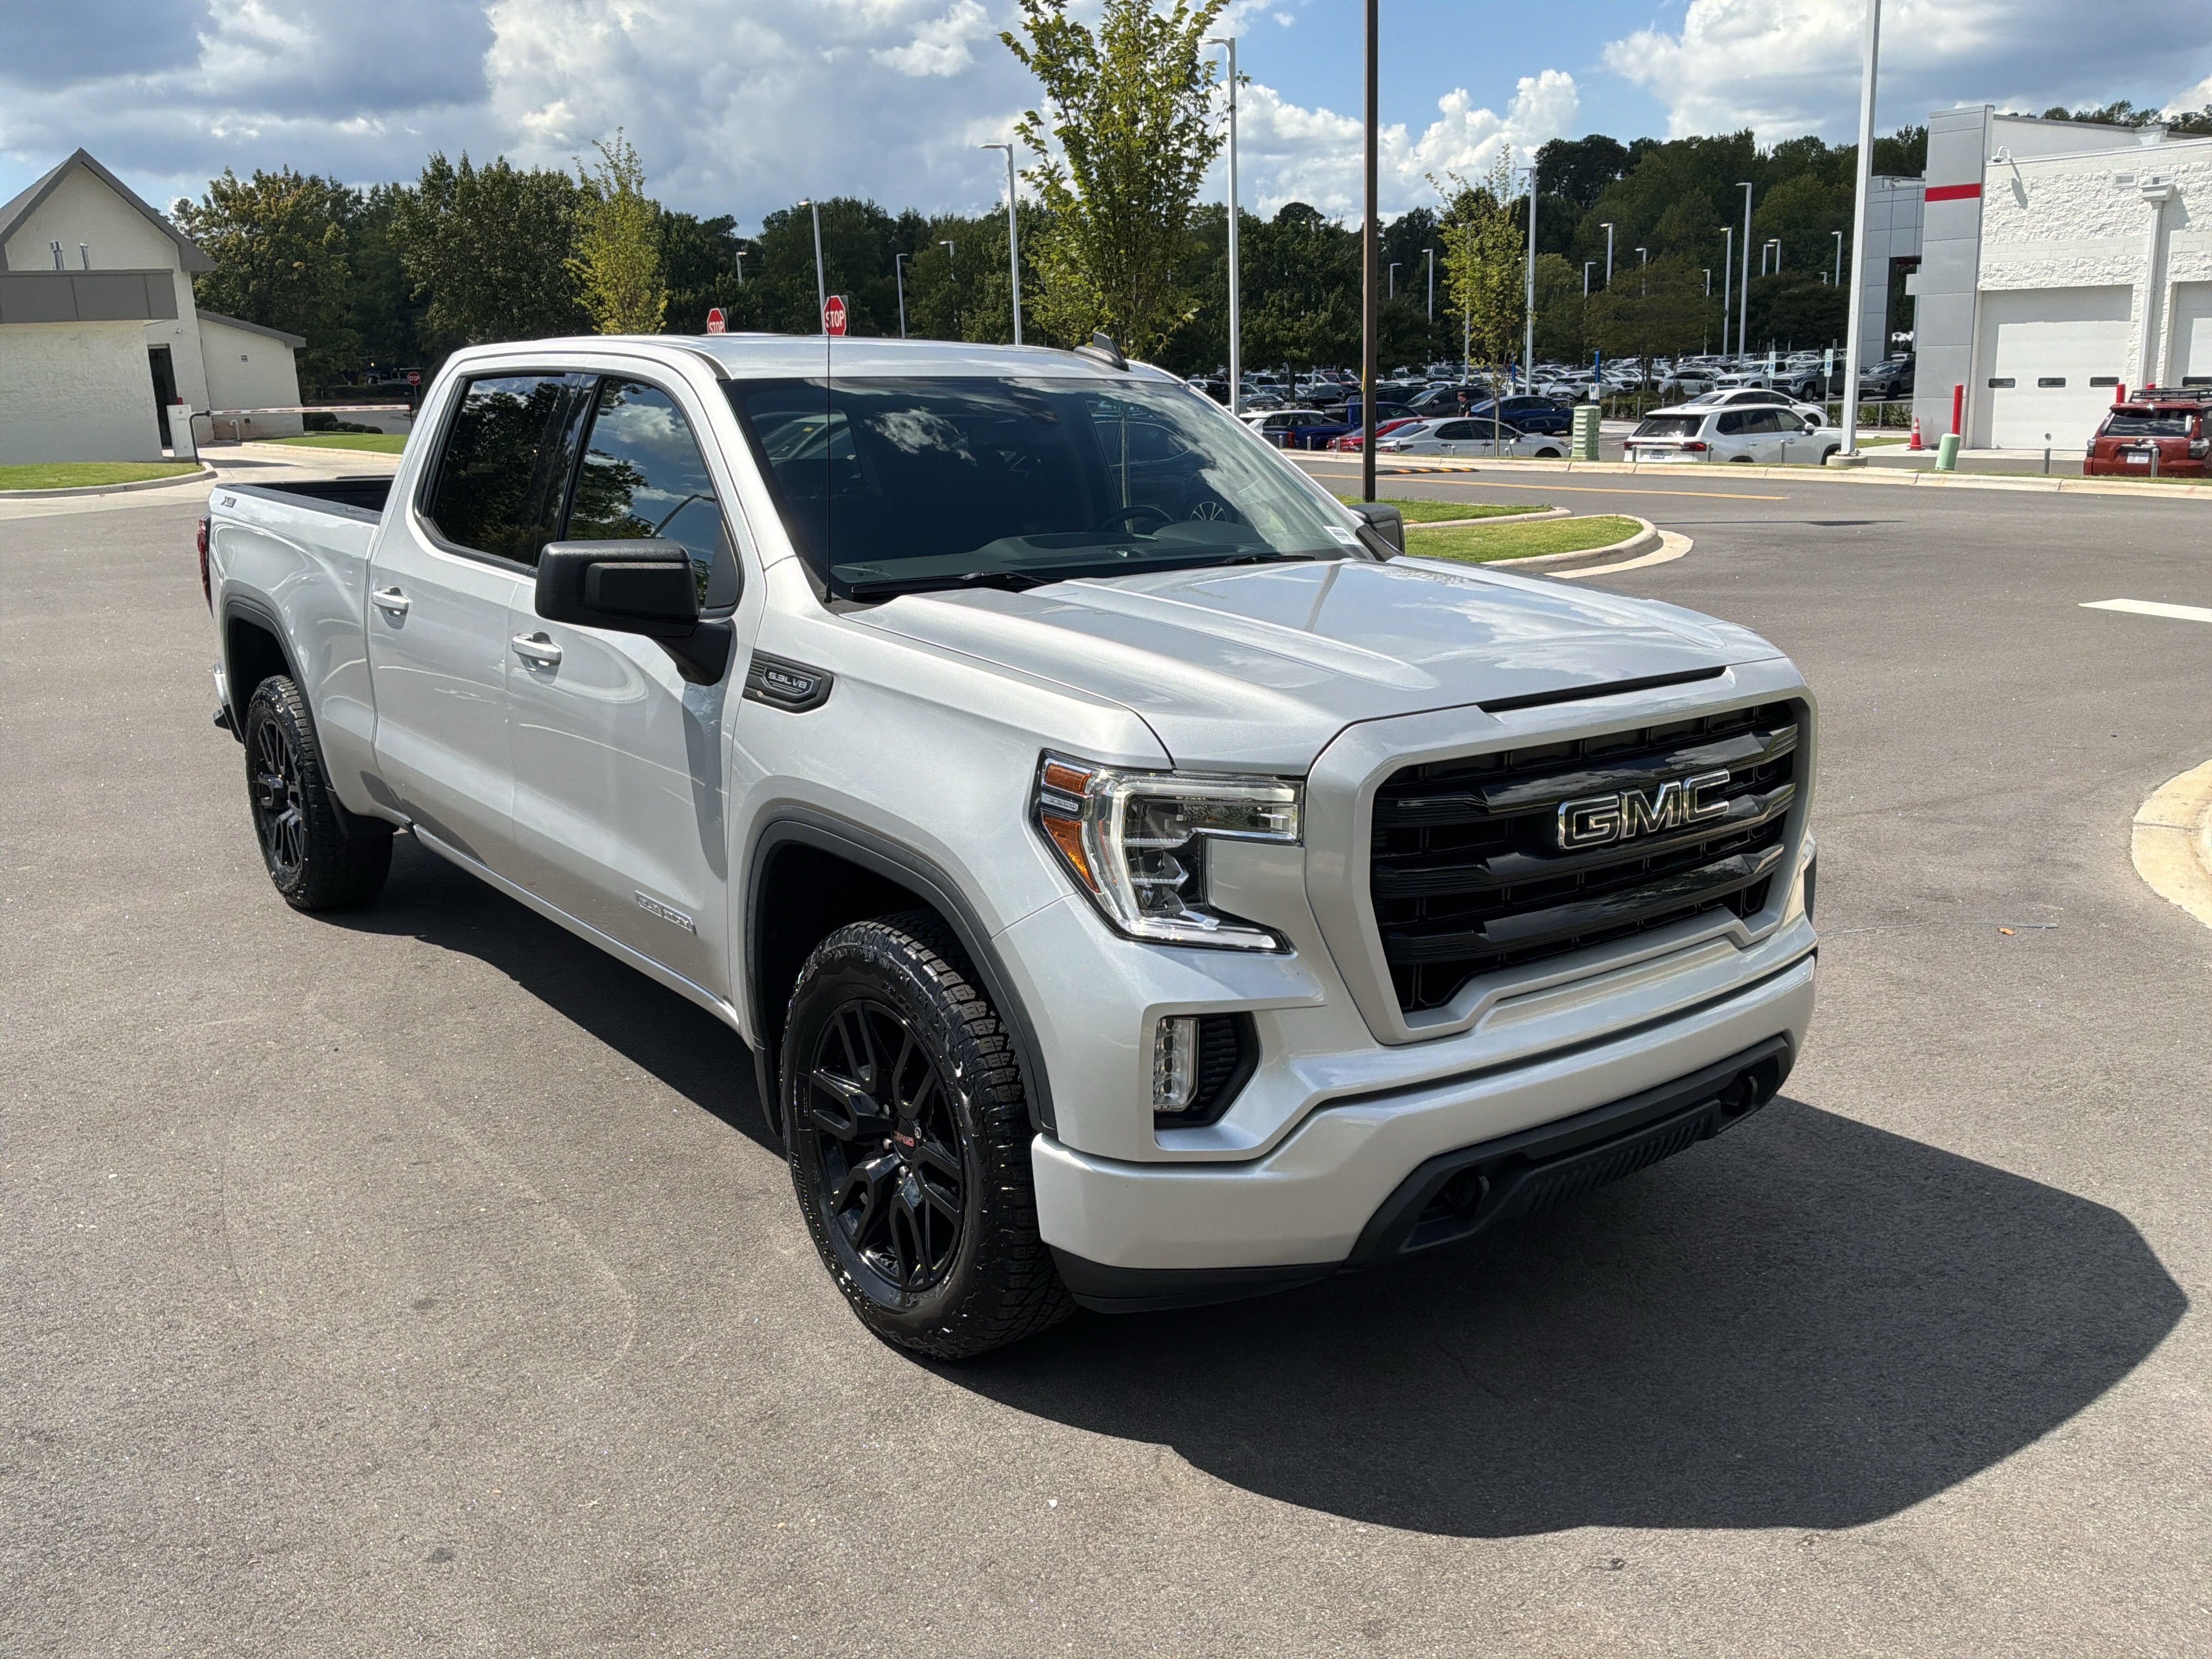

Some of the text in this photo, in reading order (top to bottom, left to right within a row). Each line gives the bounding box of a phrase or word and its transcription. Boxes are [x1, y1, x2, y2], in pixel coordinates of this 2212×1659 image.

[709, 321, 724, 334] STOP
[825, 310, 844, 328] STOP
[1558, 769, 1730, 850] GMC
